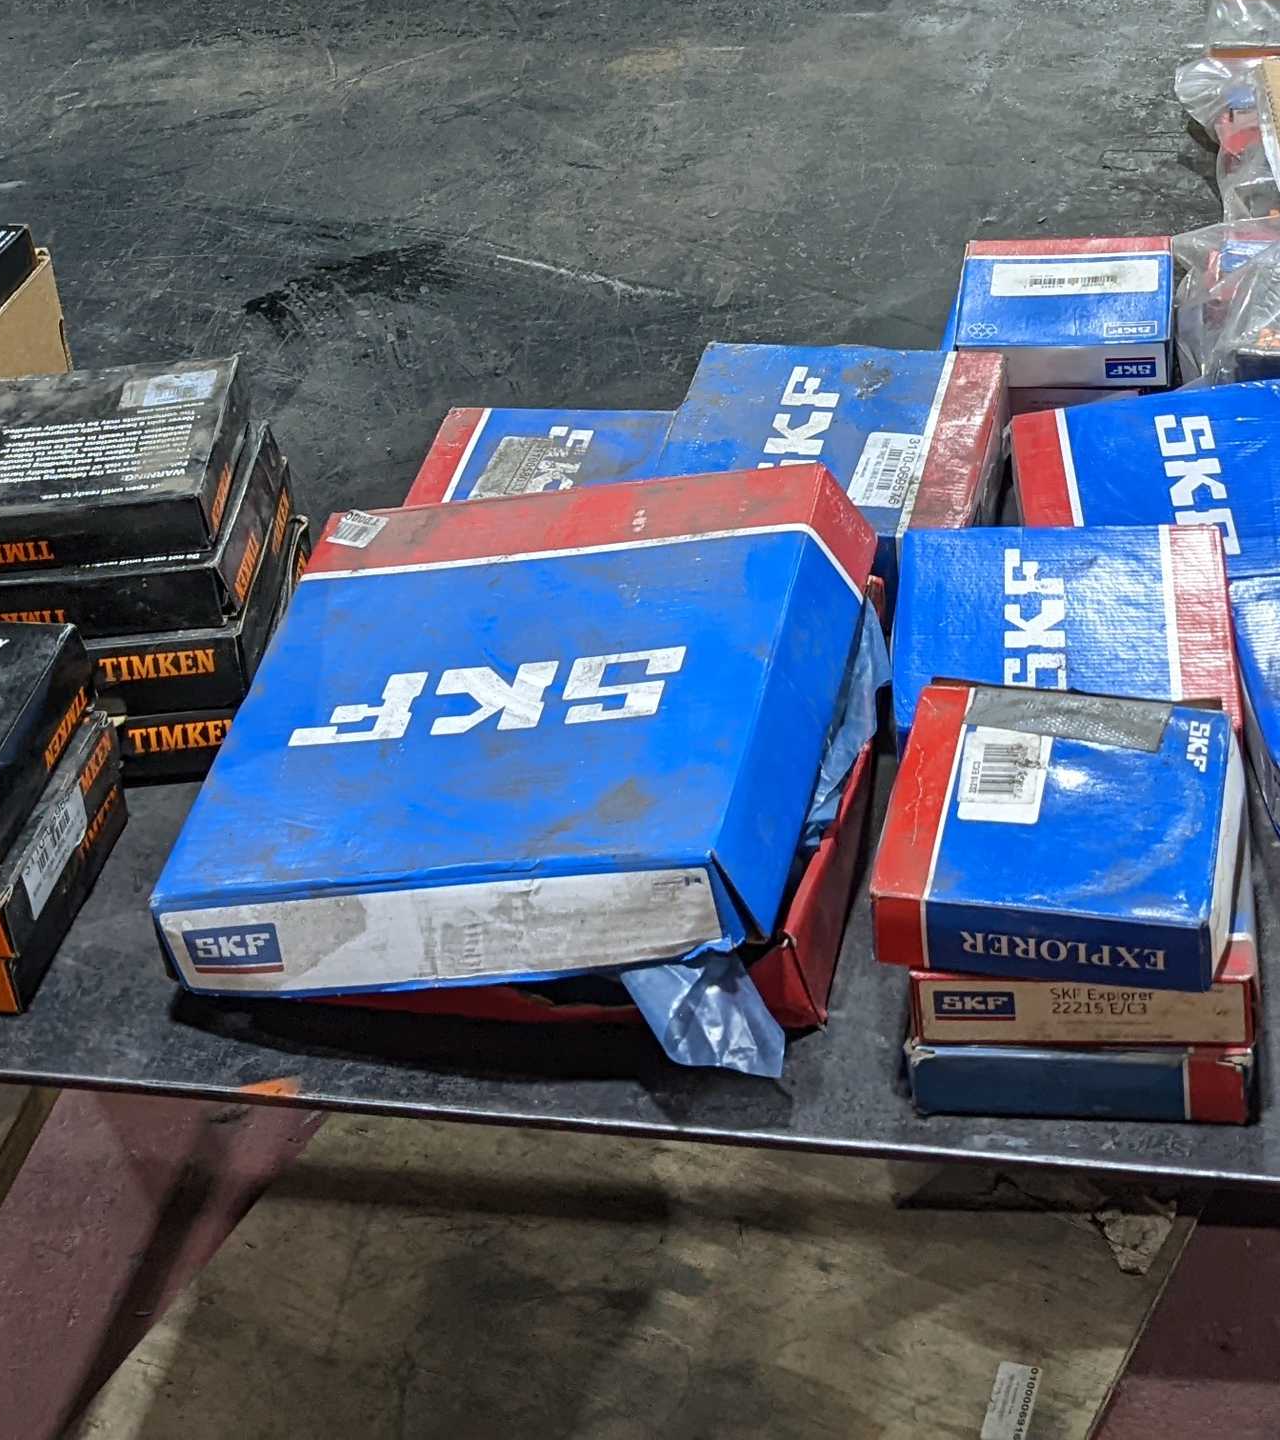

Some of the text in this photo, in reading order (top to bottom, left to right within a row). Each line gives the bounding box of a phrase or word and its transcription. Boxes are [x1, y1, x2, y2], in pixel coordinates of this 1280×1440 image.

[1109, 361, 1153, 376] SKF
[757, 366, 840, 470] KF
[1154, 414, 1242, 556] SKF
[1003, 547, 1067, 691] SKF
[98, 648, 216, 684] TIMKEN
[287, 645, 687, 748] SKF
[43, 687, 90, 772] TIMKEN
[1187, 719, 1211, 773] SKF
[194, 931, 272, 959] SKF
[959, 929, 1167, 972] EXPLORER
[941, 995, 1010, 1011] SKF
[1049, 987, 1155, 1004] SKF Explorer
[1051, 1001, 1148, 1016] 22215 E/C3
